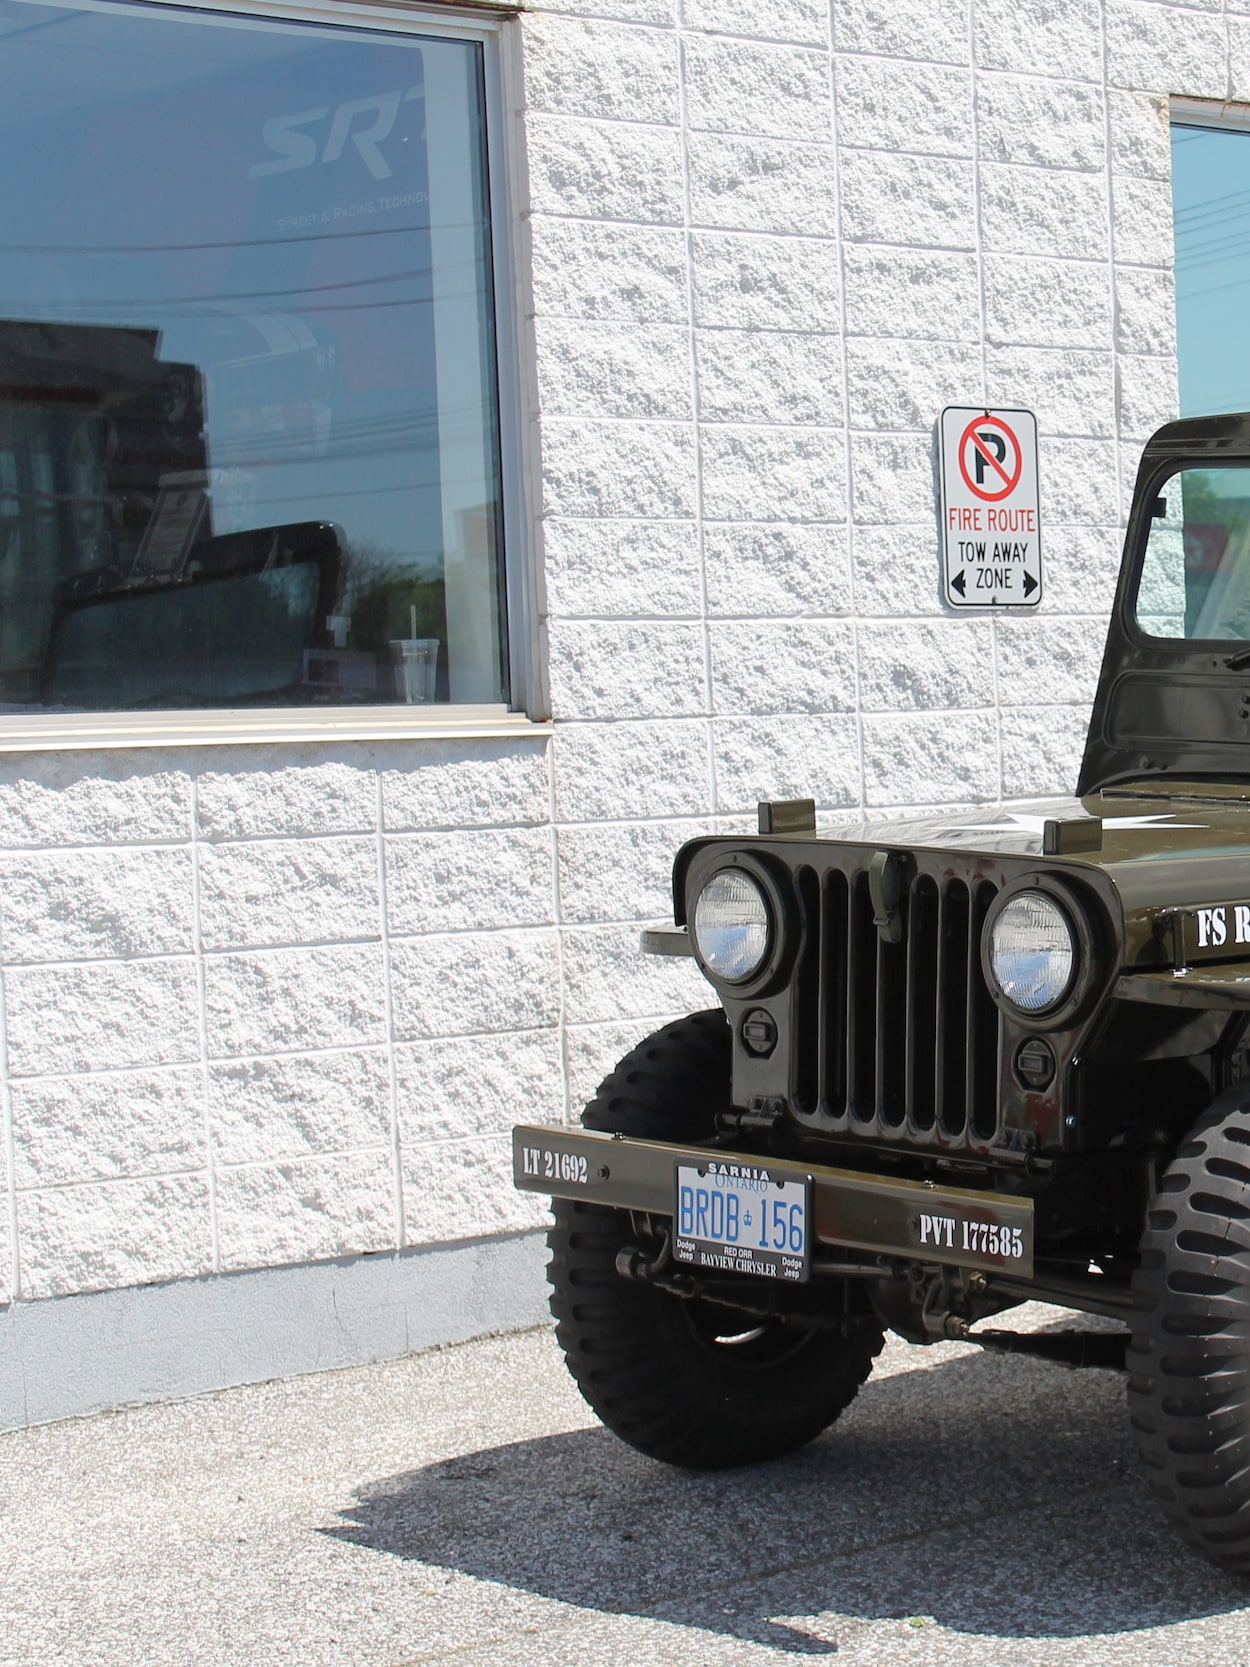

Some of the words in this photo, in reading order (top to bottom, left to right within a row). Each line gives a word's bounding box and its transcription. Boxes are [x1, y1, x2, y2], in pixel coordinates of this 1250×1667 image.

[333, 201, 376, 220] RACING
[949, 508, 982, 531] FIRE
[988, 509, 1035, 532] ROUTE
[958, 541, 986, 562] TOW
[992, 542, 1028, 562] AWAY
[976, 568, 1013, 589] ZONE
[1197, 907, 1227, 947] FS
[523, 1147, 540, 1175] LT
[544, 1151, 588, 1184] 21692
[708, 1162, 769, 1181] SARNIA
[715, 1175, 768, 1193] ONTARIO
[680, 1186, 739, 1242] BRDB
[759, 1199, 803, 1253] 156
[677, 1239, 695, 1251] Dodge
[920, 1214, 955, 1248] PVT
[962, 1221, 1023, 1258] 177585
[679, 1250, 693, 1261] Jeep
[724, 1246, 737, 1257] RED
[738, 1248, 752, 1259] ORR
[701, 1252, 736, 1270] BAYVIEW
[736, 1258, 776, 1277] CHRYSLER
[782, 1257, 802, 1269] Dodge
[784, 1268, 800, 1280] Jeep
